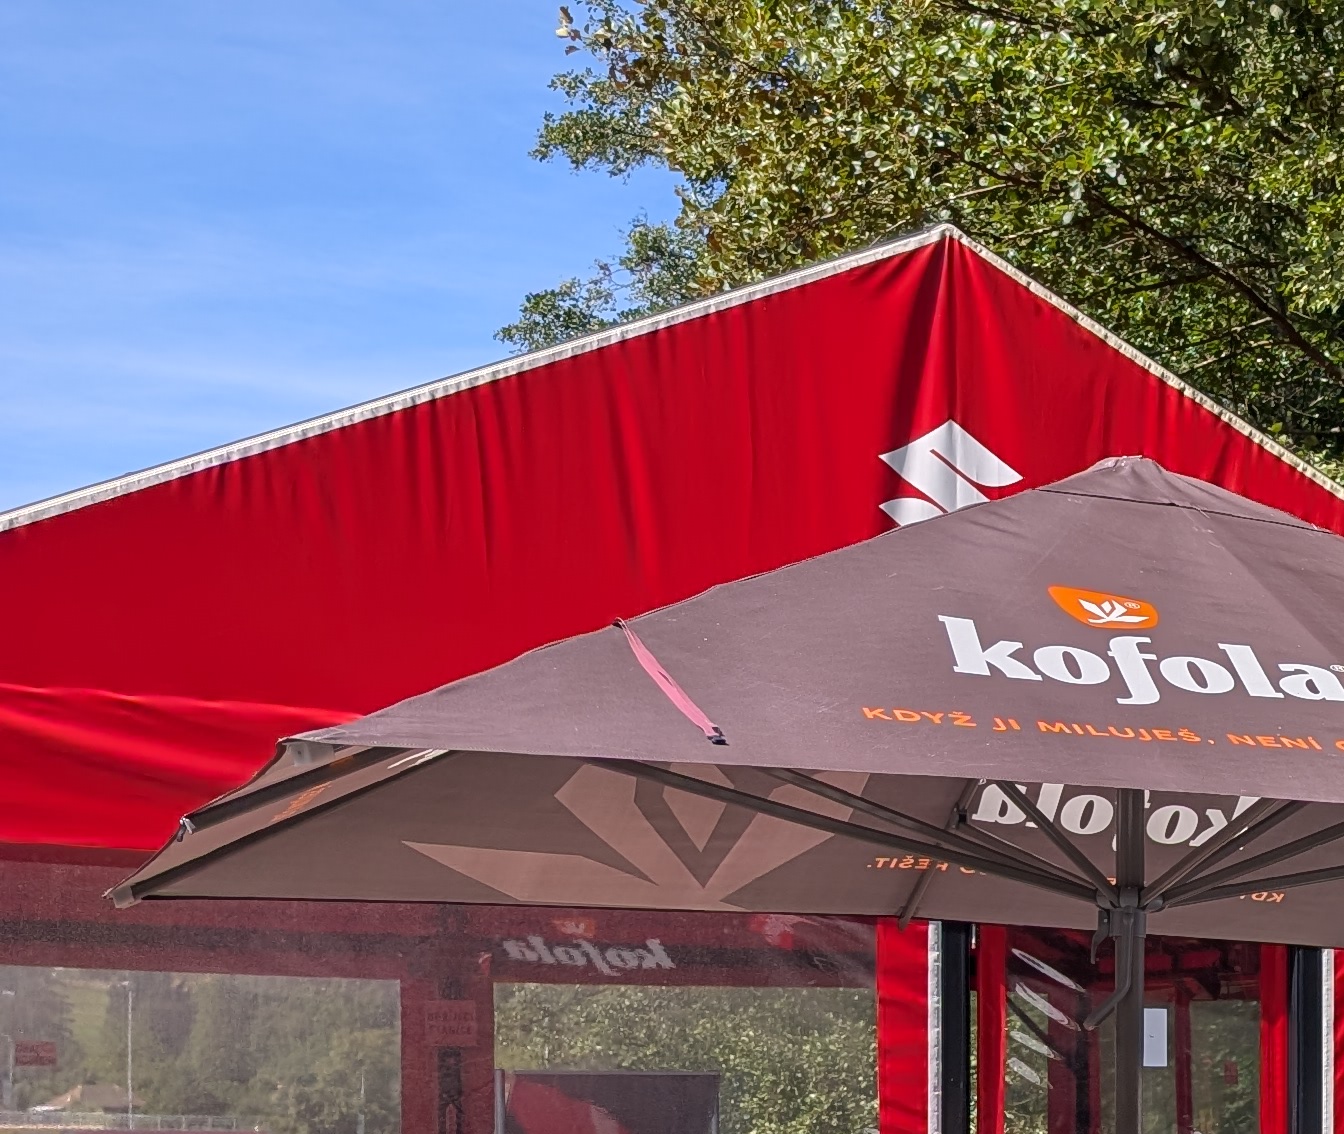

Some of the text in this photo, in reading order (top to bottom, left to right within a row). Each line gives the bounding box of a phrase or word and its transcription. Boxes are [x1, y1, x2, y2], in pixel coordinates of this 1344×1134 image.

[862, 707, 977, 727] KDYŽ
[992, 717, 1021, 732] JI
[1036, 720, 1215, 744] MILUJEŠ,
[1226, 732, 1323, 751] NENÍ
